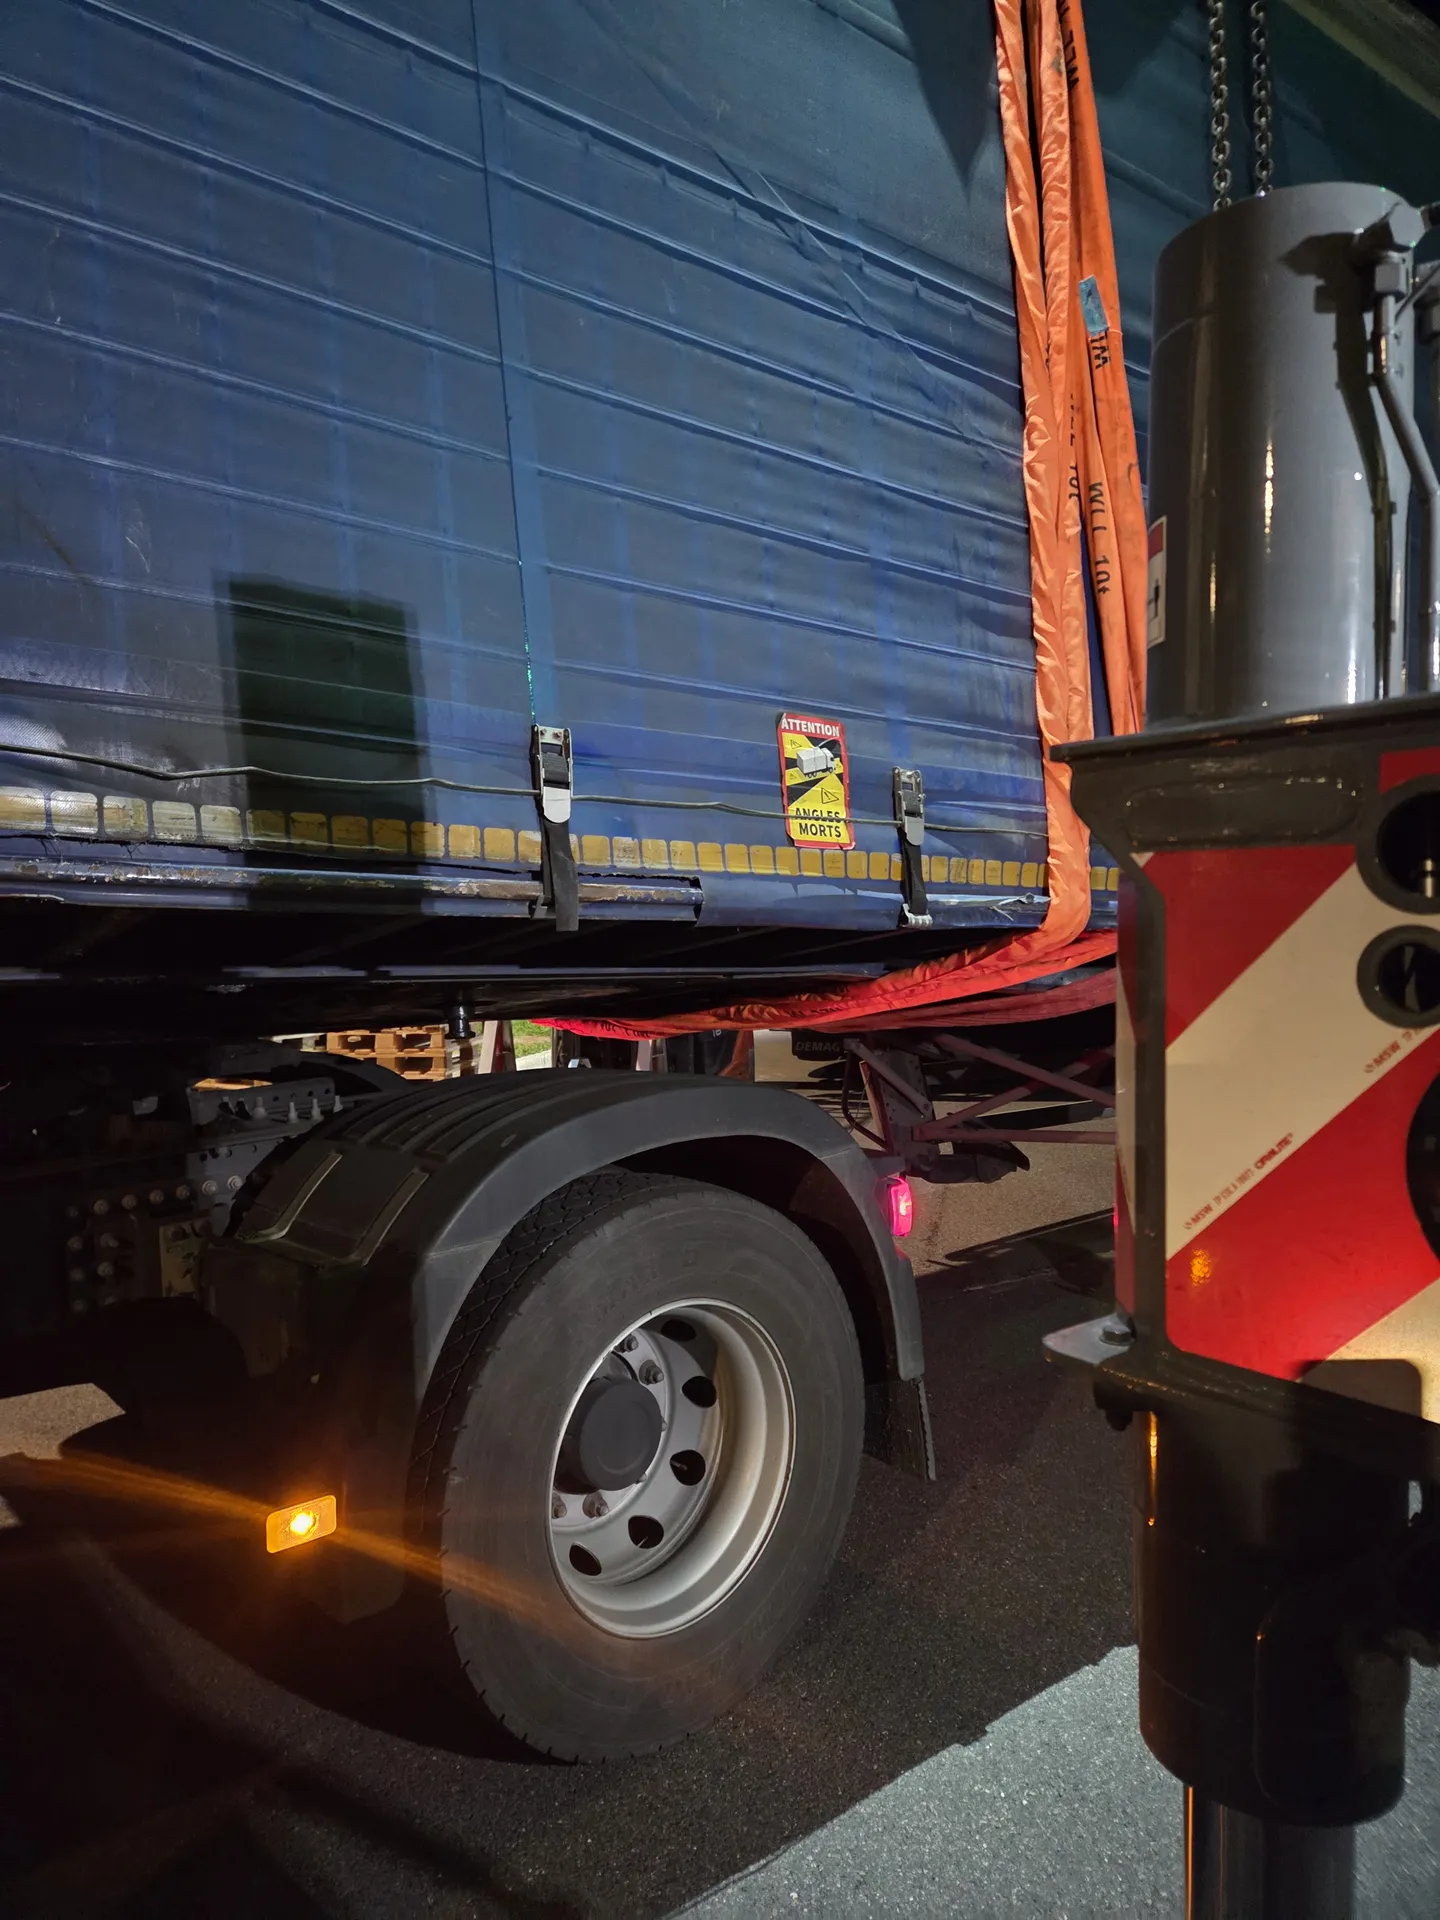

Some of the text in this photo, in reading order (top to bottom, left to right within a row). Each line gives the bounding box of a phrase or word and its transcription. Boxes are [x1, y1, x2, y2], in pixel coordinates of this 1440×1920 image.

[781, 718, 840, 737] ATTENTION
[795, 807, 841, 824] ANGLES
[798, 822, 842, 838] MORTS
[796, 1041, 840, 1052] DEMAG
